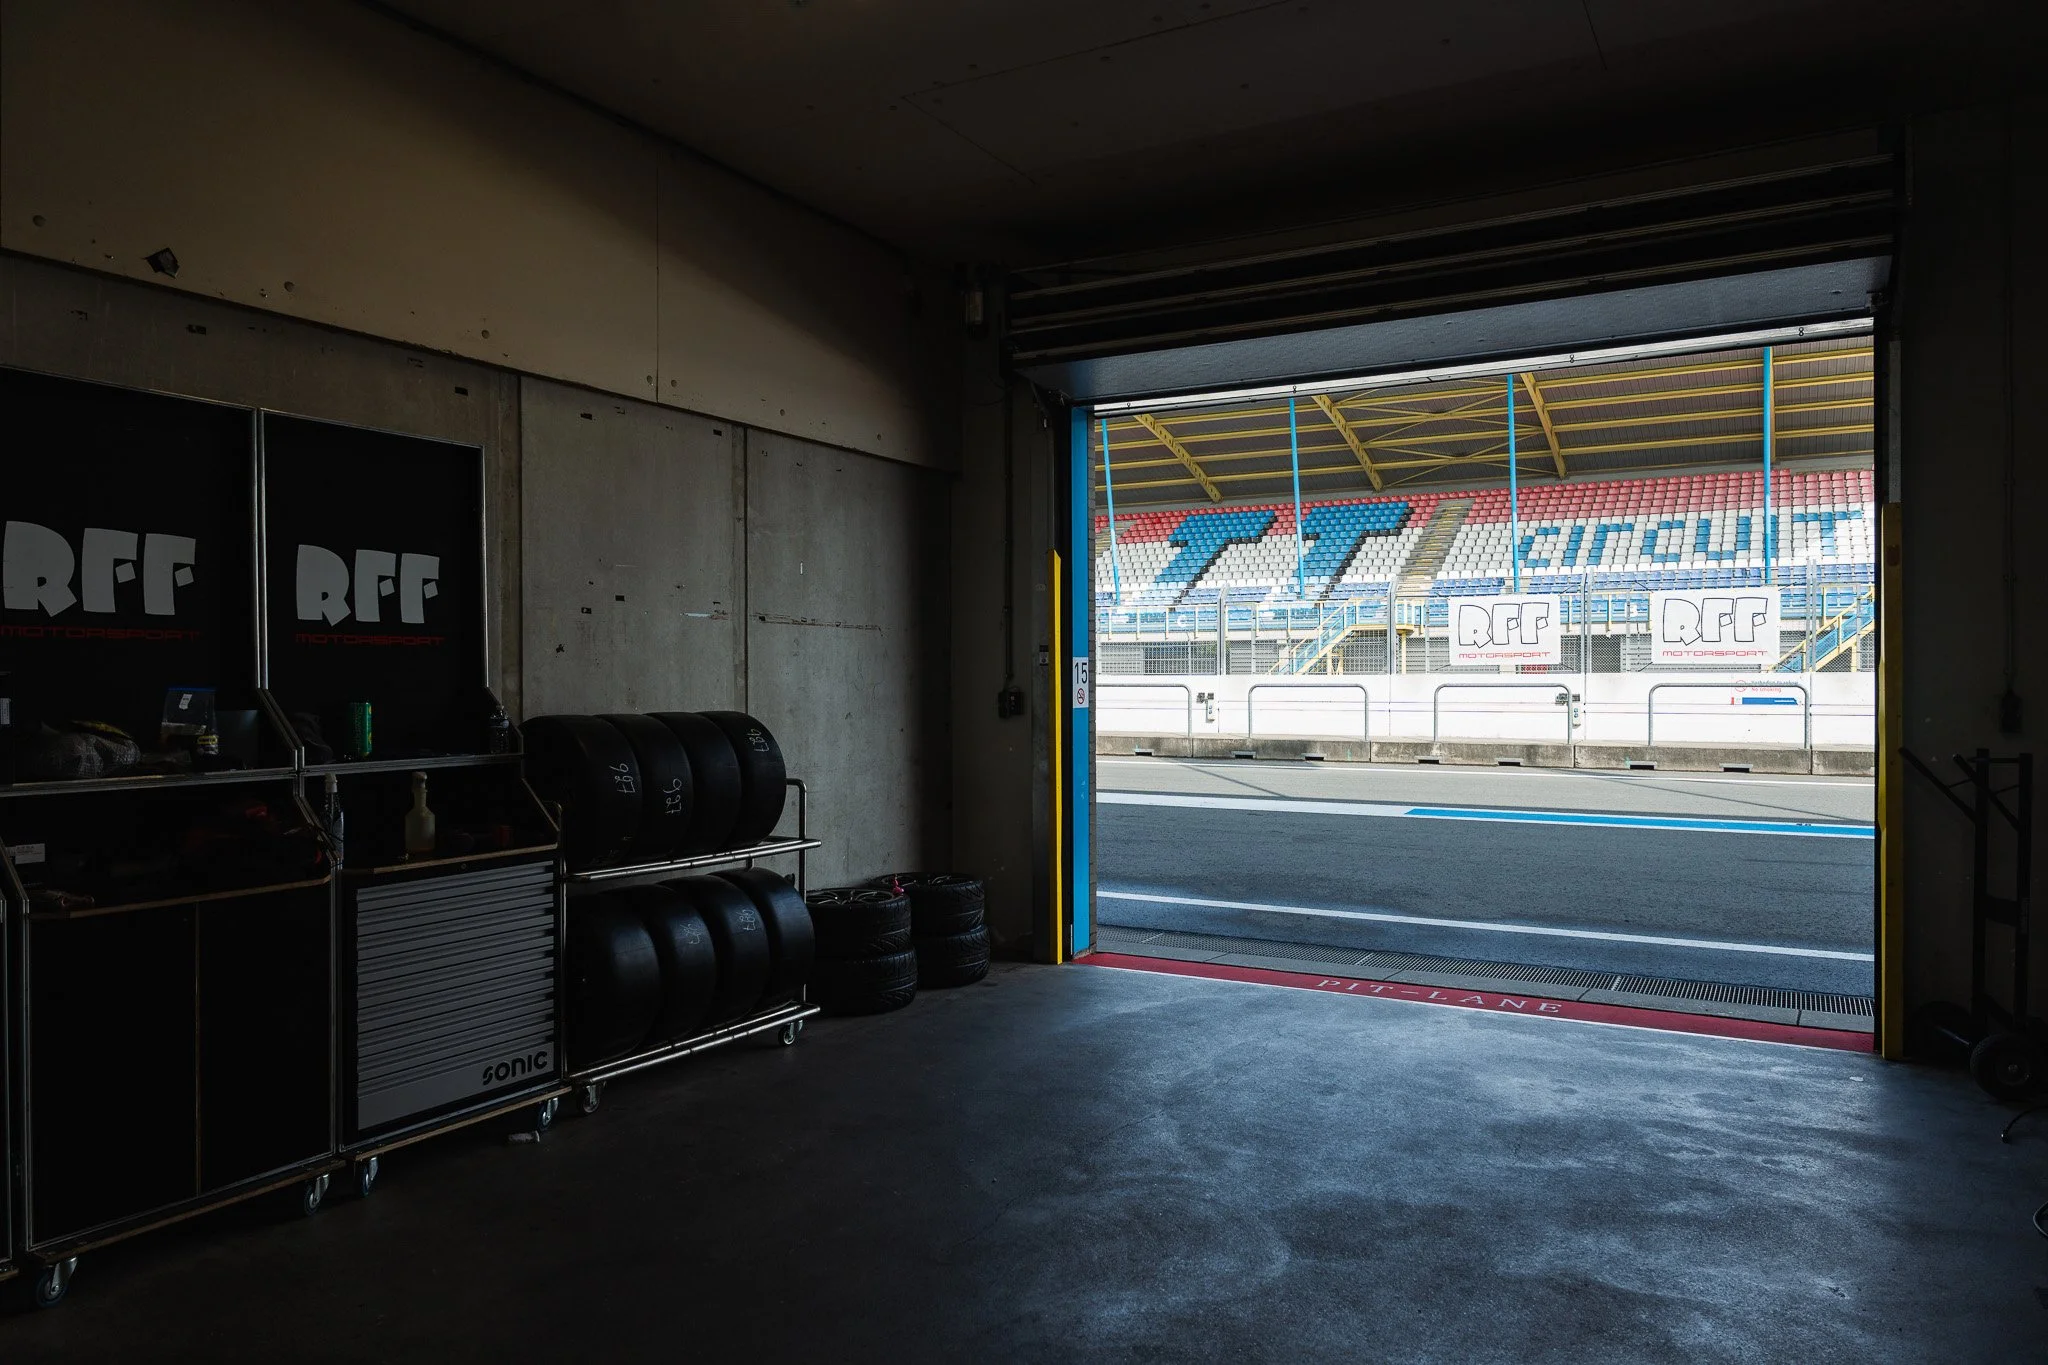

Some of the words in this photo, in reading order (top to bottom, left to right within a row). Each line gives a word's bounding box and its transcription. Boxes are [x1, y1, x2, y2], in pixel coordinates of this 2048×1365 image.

[1151, 500, 1414, 602] TT
[1516, 511, 1863, 567] CIRCUIT
[3, 520, 197, 617] RFF
[295, 543, 441, 627] RFF
[0, 625, 201, 641] MOTORSPORT
[295, 632, 446, 647] MOTORSPORT
[1458, 602, 1550, 649] RFF
[1663, 596, 1768, 647] RFF
[1074, 661, 1089, 685] 15
[1458, 651, 1551, 659] MOTORSPORT
[1662, 649, 1768, 657] MOTORSPORT
[1316, 979, 1563, 1014] PIT-LANE
